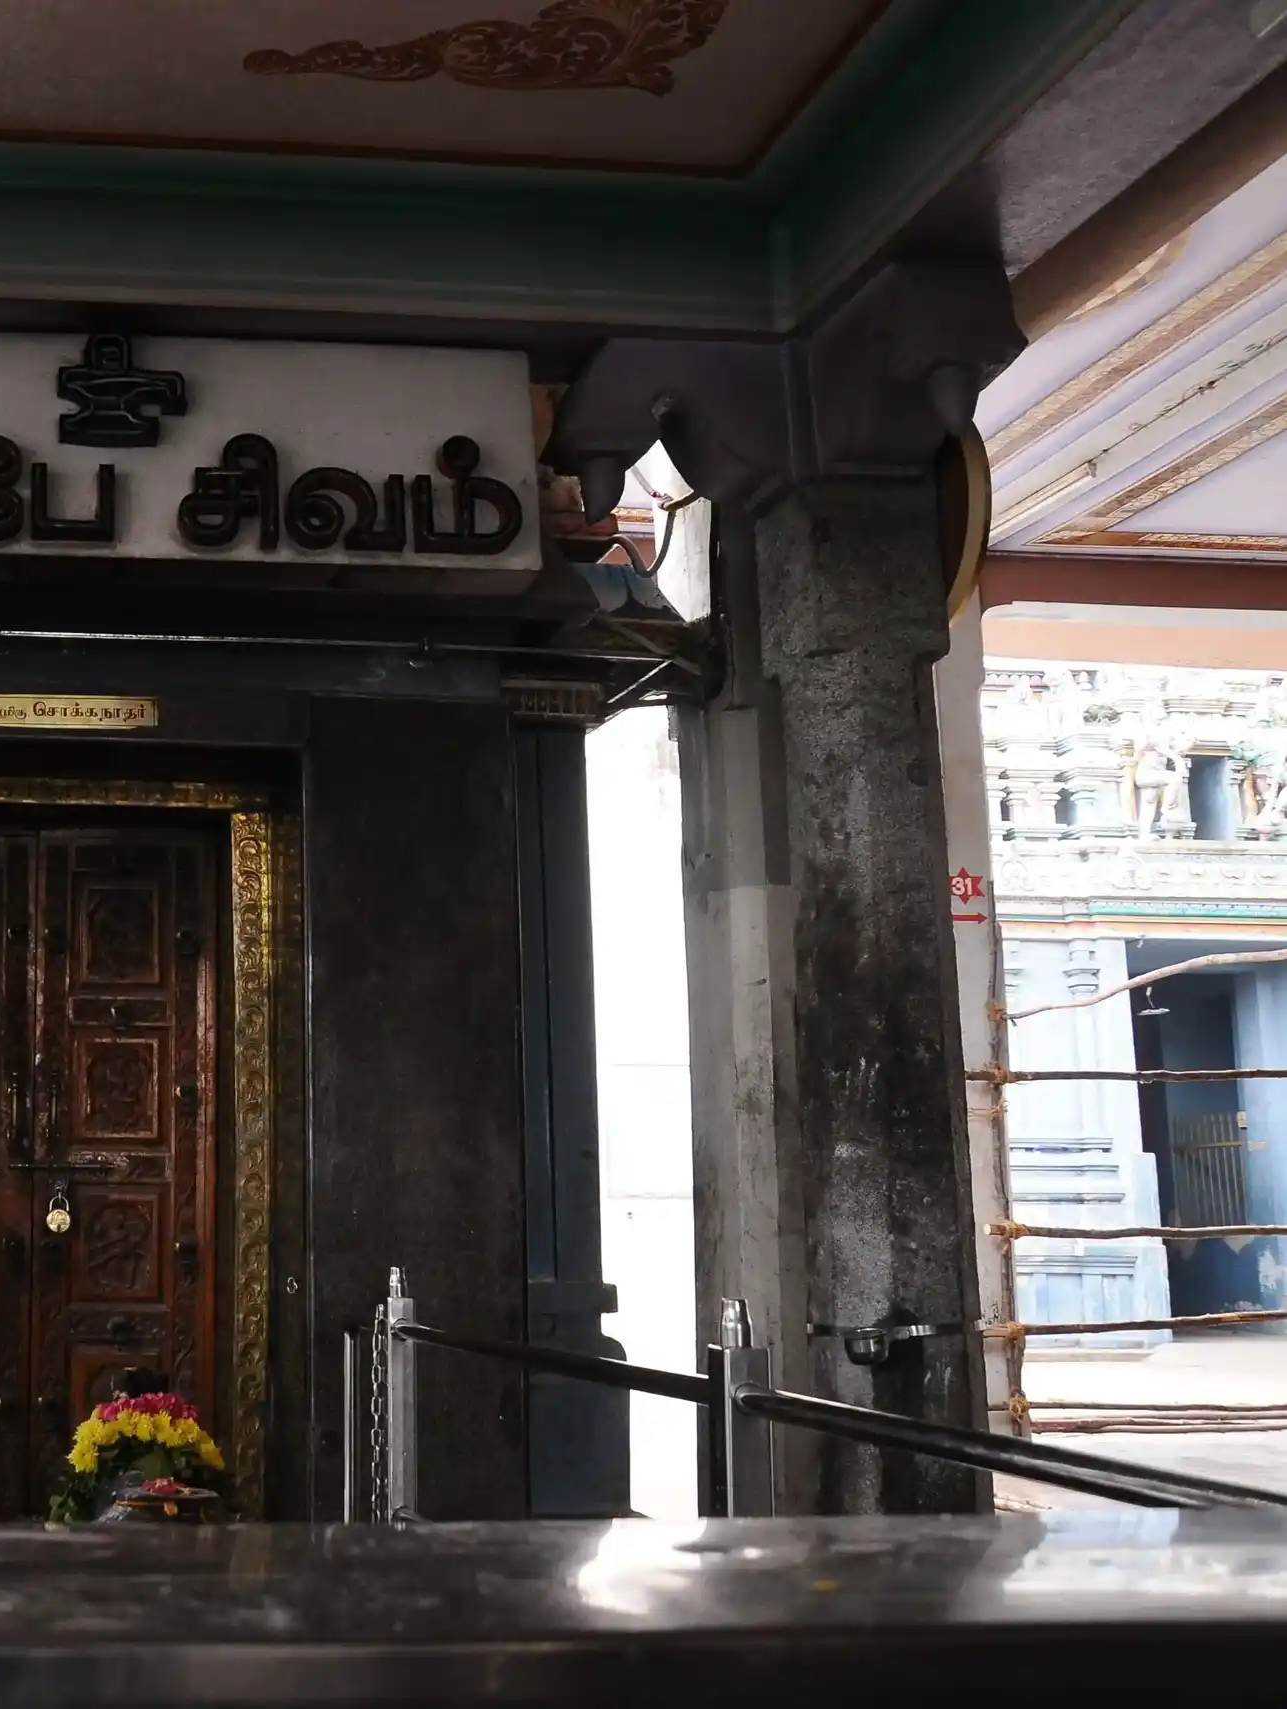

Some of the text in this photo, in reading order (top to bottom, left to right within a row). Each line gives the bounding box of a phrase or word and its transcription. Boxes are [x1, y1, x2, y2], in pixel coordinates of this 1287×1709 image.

[177, 432, 525, 553] சிவம்
[32, 701, 147, 723] சொக்கநாதர்
[951, 876, 973, 896] 31
